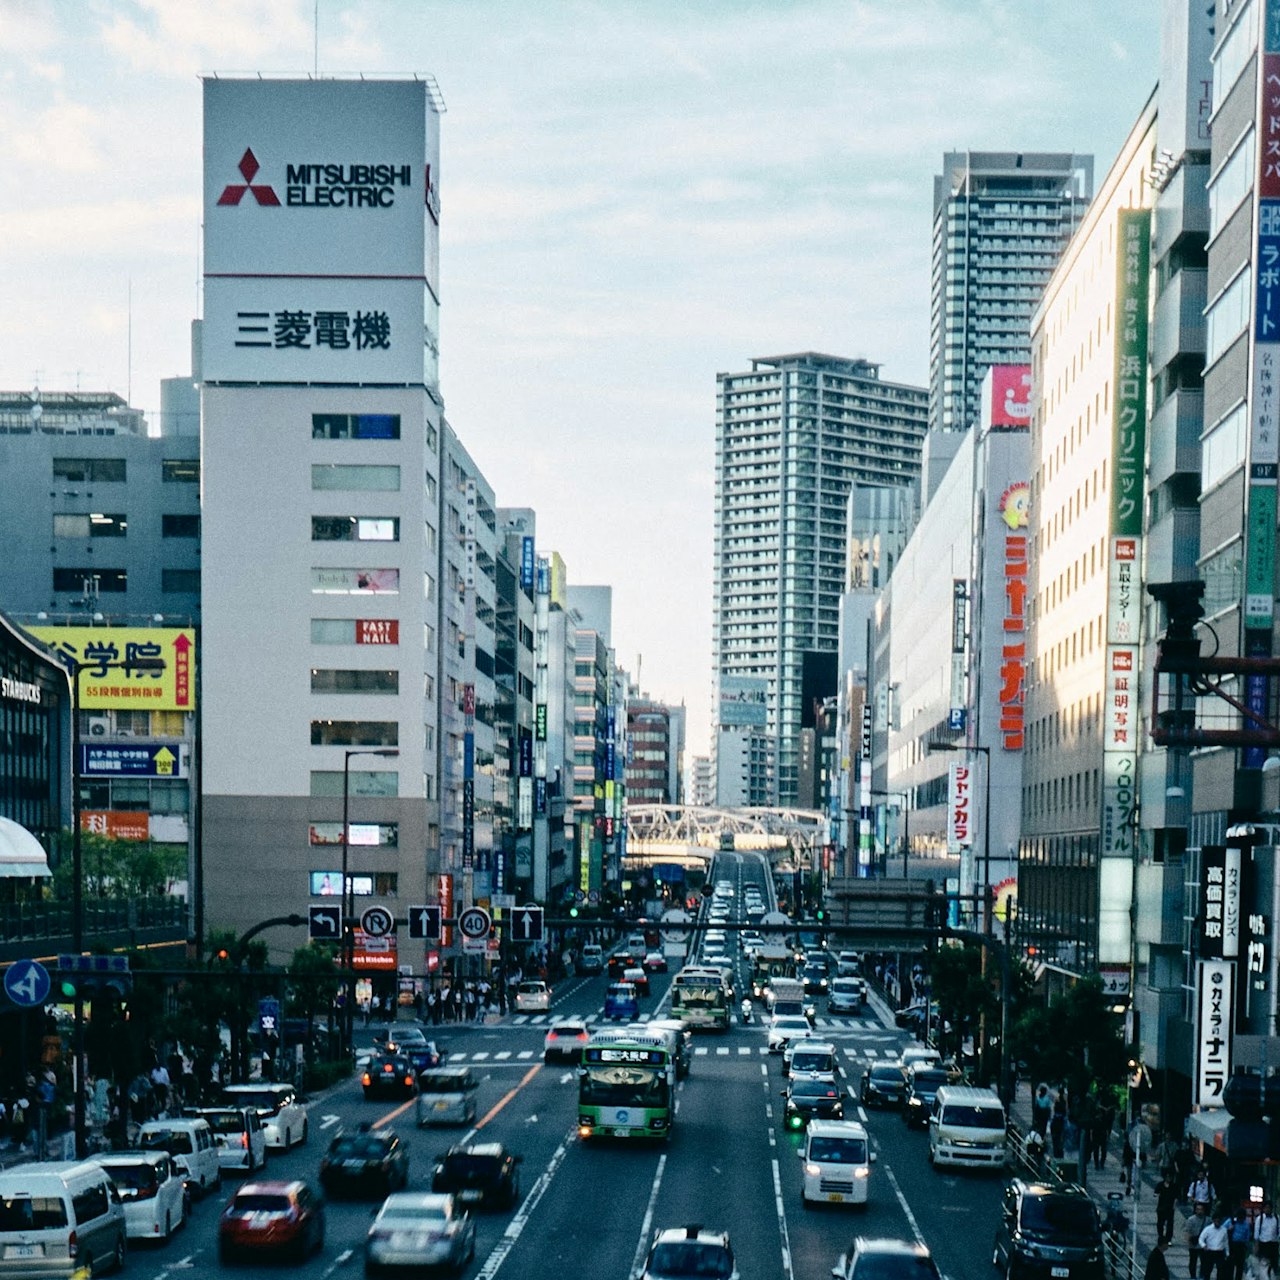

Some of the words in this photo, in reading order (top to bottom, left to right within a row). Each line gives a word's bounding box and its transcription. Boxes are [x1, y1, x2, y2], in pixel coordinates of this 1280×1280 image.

[287, 164, 411, 186] MITSUBISHI
[287, 186, 394, 208] ELECTRIC
[1261, 245, 1279, 337] ラポート
[235, 310, 391, 350] 三菱電機
[1125, 298, 1138, 342] 皮フ科
[1118, 354, 1141, 521] 浜口クリニック
[1257, 467, 1272, 477] 9F
[1119, 562, 1131, 619] 買取センター
[363, 622, 391, 632] FAST
[363, 632, 391, 644] NAIL
[2, 677, 41, 704] STARBUCKS
[1113, 676, 1128, 743] 証明写真
[1206, 866, 1223, 939] 高価買取
[1227, 867, 1238, 937] カメラ・レンズ
[464, 914, 483, 932] 40
[366, 955, 394, 964] Kitchen
[1205, 987, 1224, 1096] カメラのナニワ
